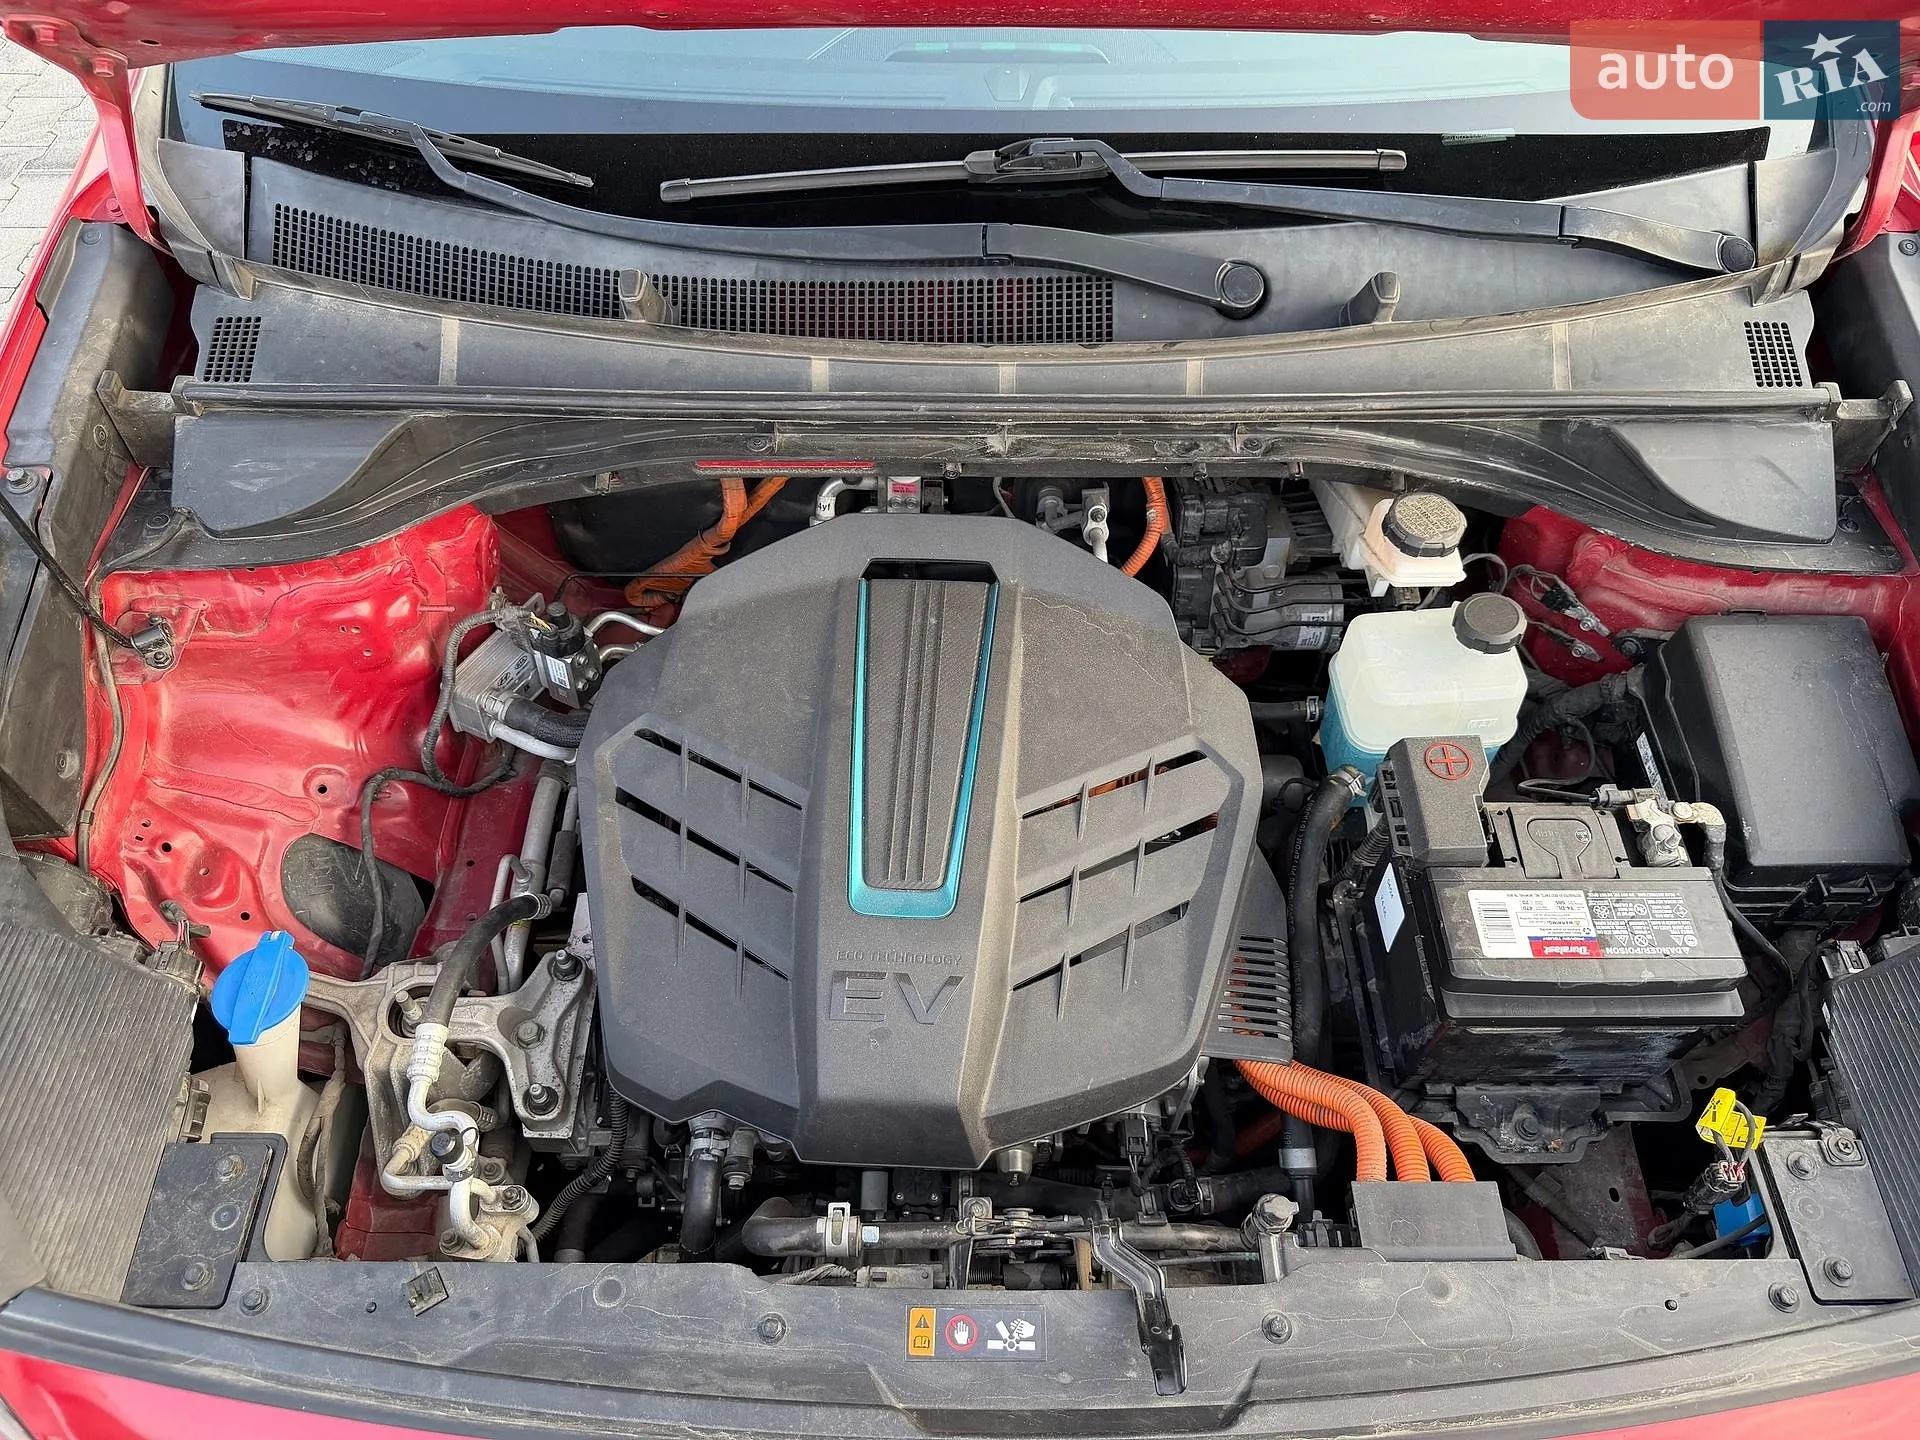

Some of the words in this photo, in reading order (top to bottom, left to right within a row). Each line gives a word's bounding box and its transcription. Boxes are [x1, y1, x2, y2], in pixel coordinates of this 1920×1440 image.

[836, 949, 863, 962] ECO
[870, 950, 962, 965] TECHNOLOGY
[1543, 944, 1590, 956] Duralast
[829, 970, 965, 1025] EV
